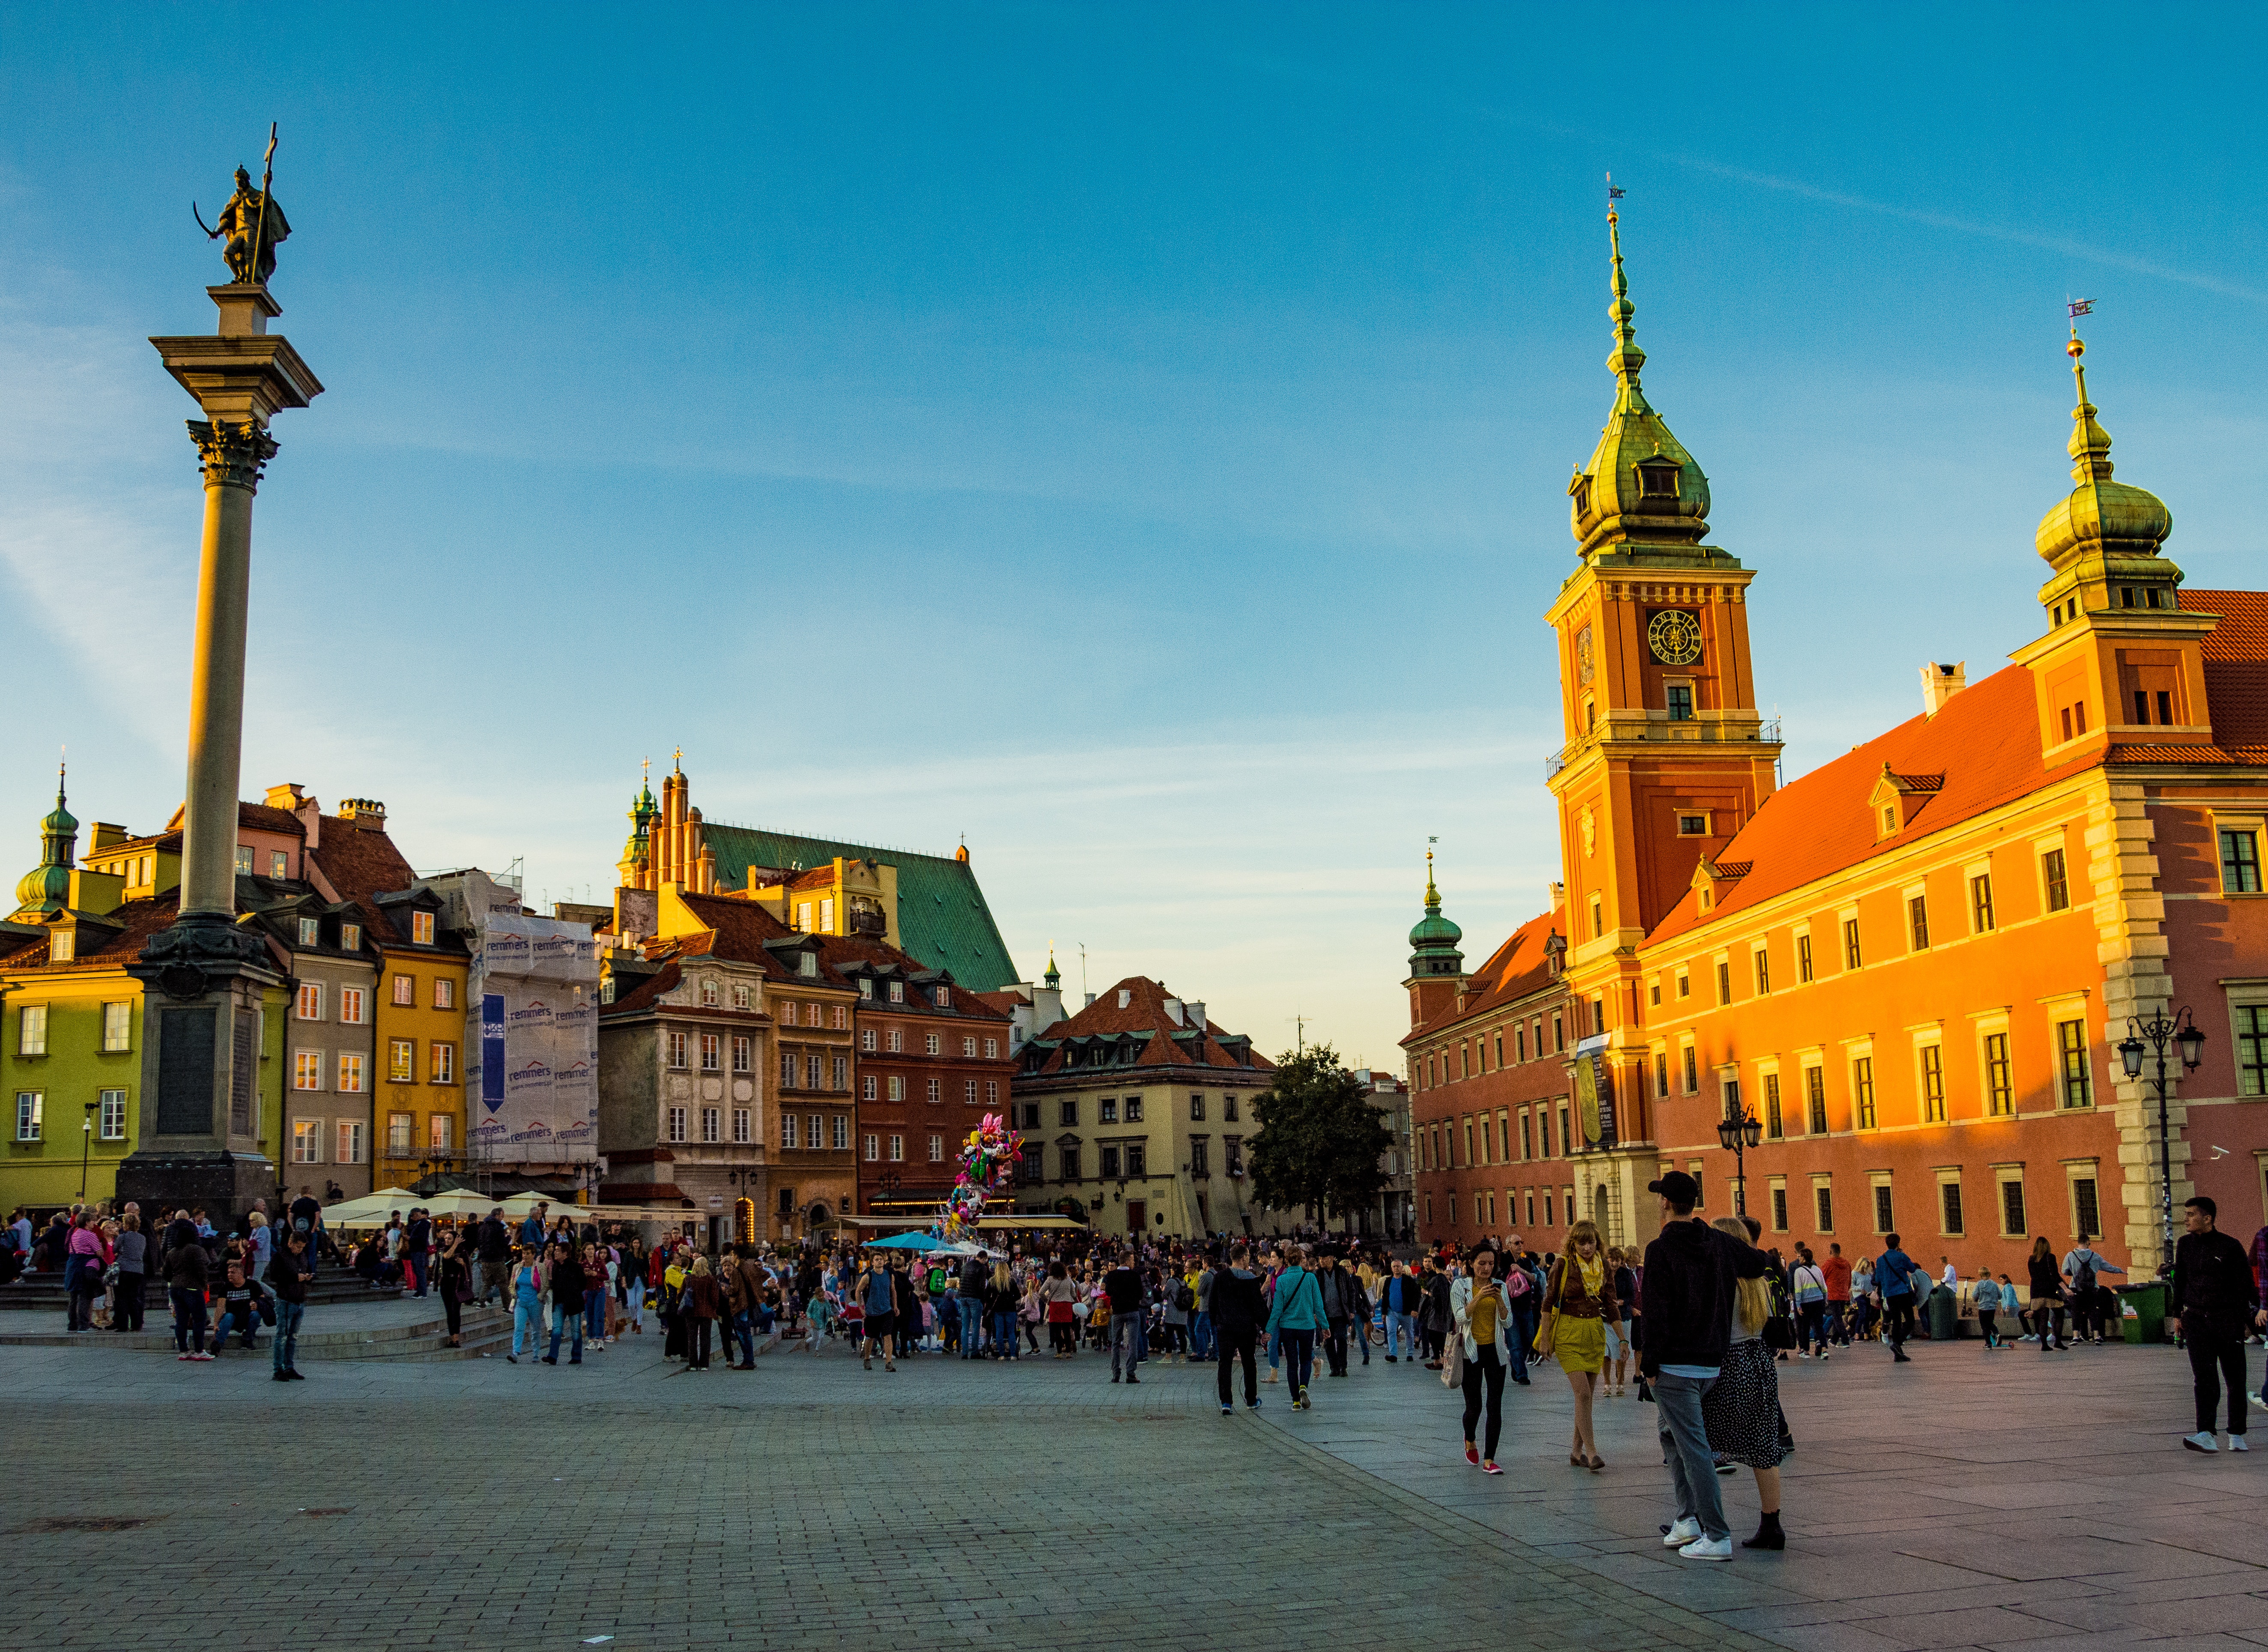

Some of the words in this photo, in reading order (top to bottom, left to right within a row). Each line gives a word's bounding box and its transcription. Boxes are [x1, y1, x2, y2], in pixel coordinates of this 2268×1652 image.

[486, 940, 529, 951] remmers
[510, 1007, 551, 1020] remmers
[508, 1066, 551, 1081] remmers
[467, 1124, 506, 1138] remmers
[510, 1128, 551, 1143] remmers
